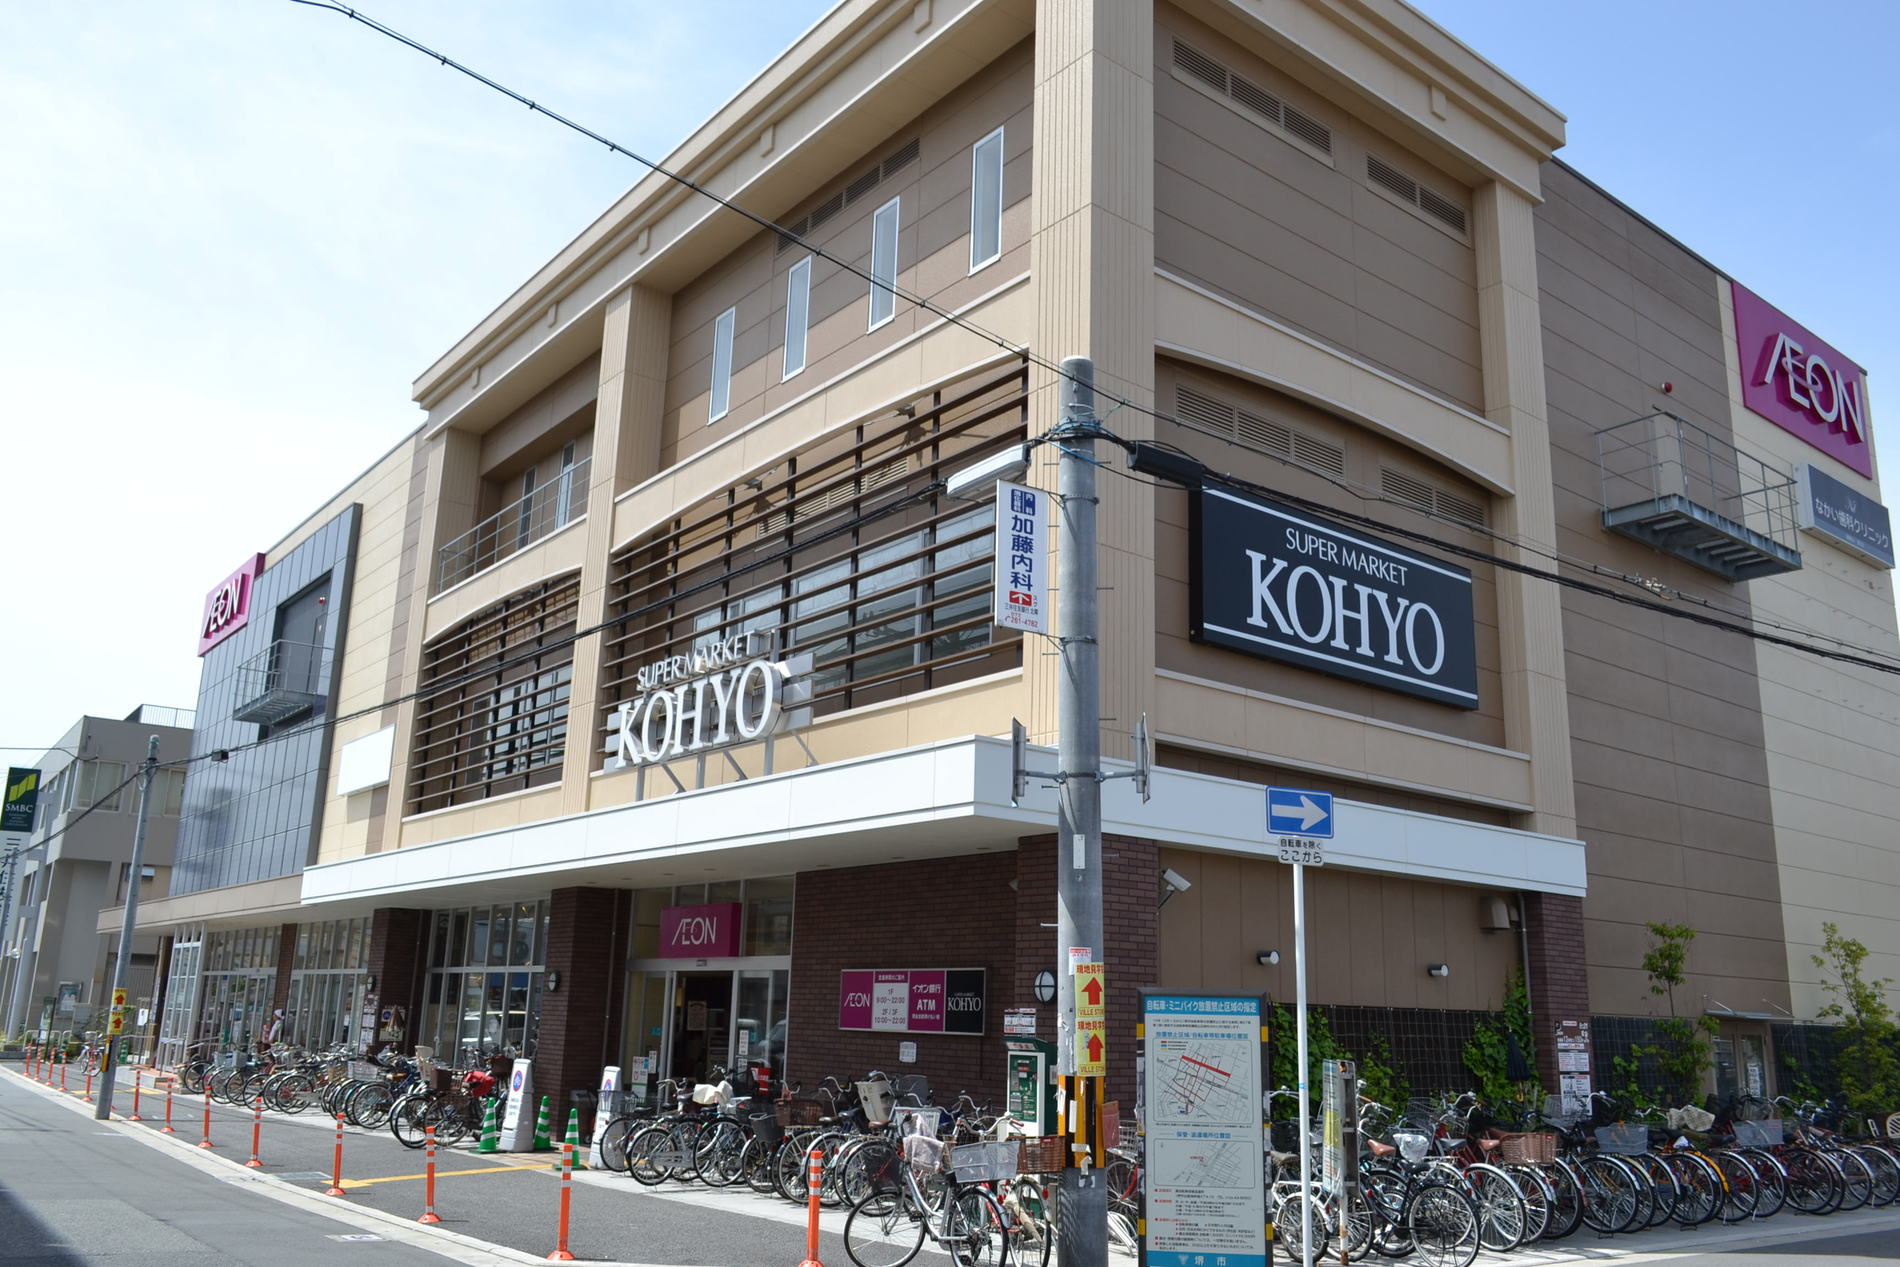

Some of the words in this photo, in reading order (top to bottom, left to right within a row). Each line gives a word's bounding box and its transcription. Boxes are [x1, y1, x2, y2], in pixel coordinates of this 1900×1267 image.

[1815, 497, 1889, 548] なかい歯科クリニック
[1010, 514, 1034, 591] 加藤内科
[1286, 528, 1338, 564] SUPER
[1342, 546, 1408, 586] MARKET
[1245, 548, 1445, 676] KOHYO
[636, 656, 680, 688] SUPER
[683, 631, 757, 678] MARKET
[614, 660, 775, 768] KOHYO
[5, 803, 33, 813] SMBC
[1281, 849, 1322, 864] ここから
[912, 984, 941, 994] イオン銀行
[916, 999, 936, 1011] ATM
[947, 997, 981, 1012] KOHYO
